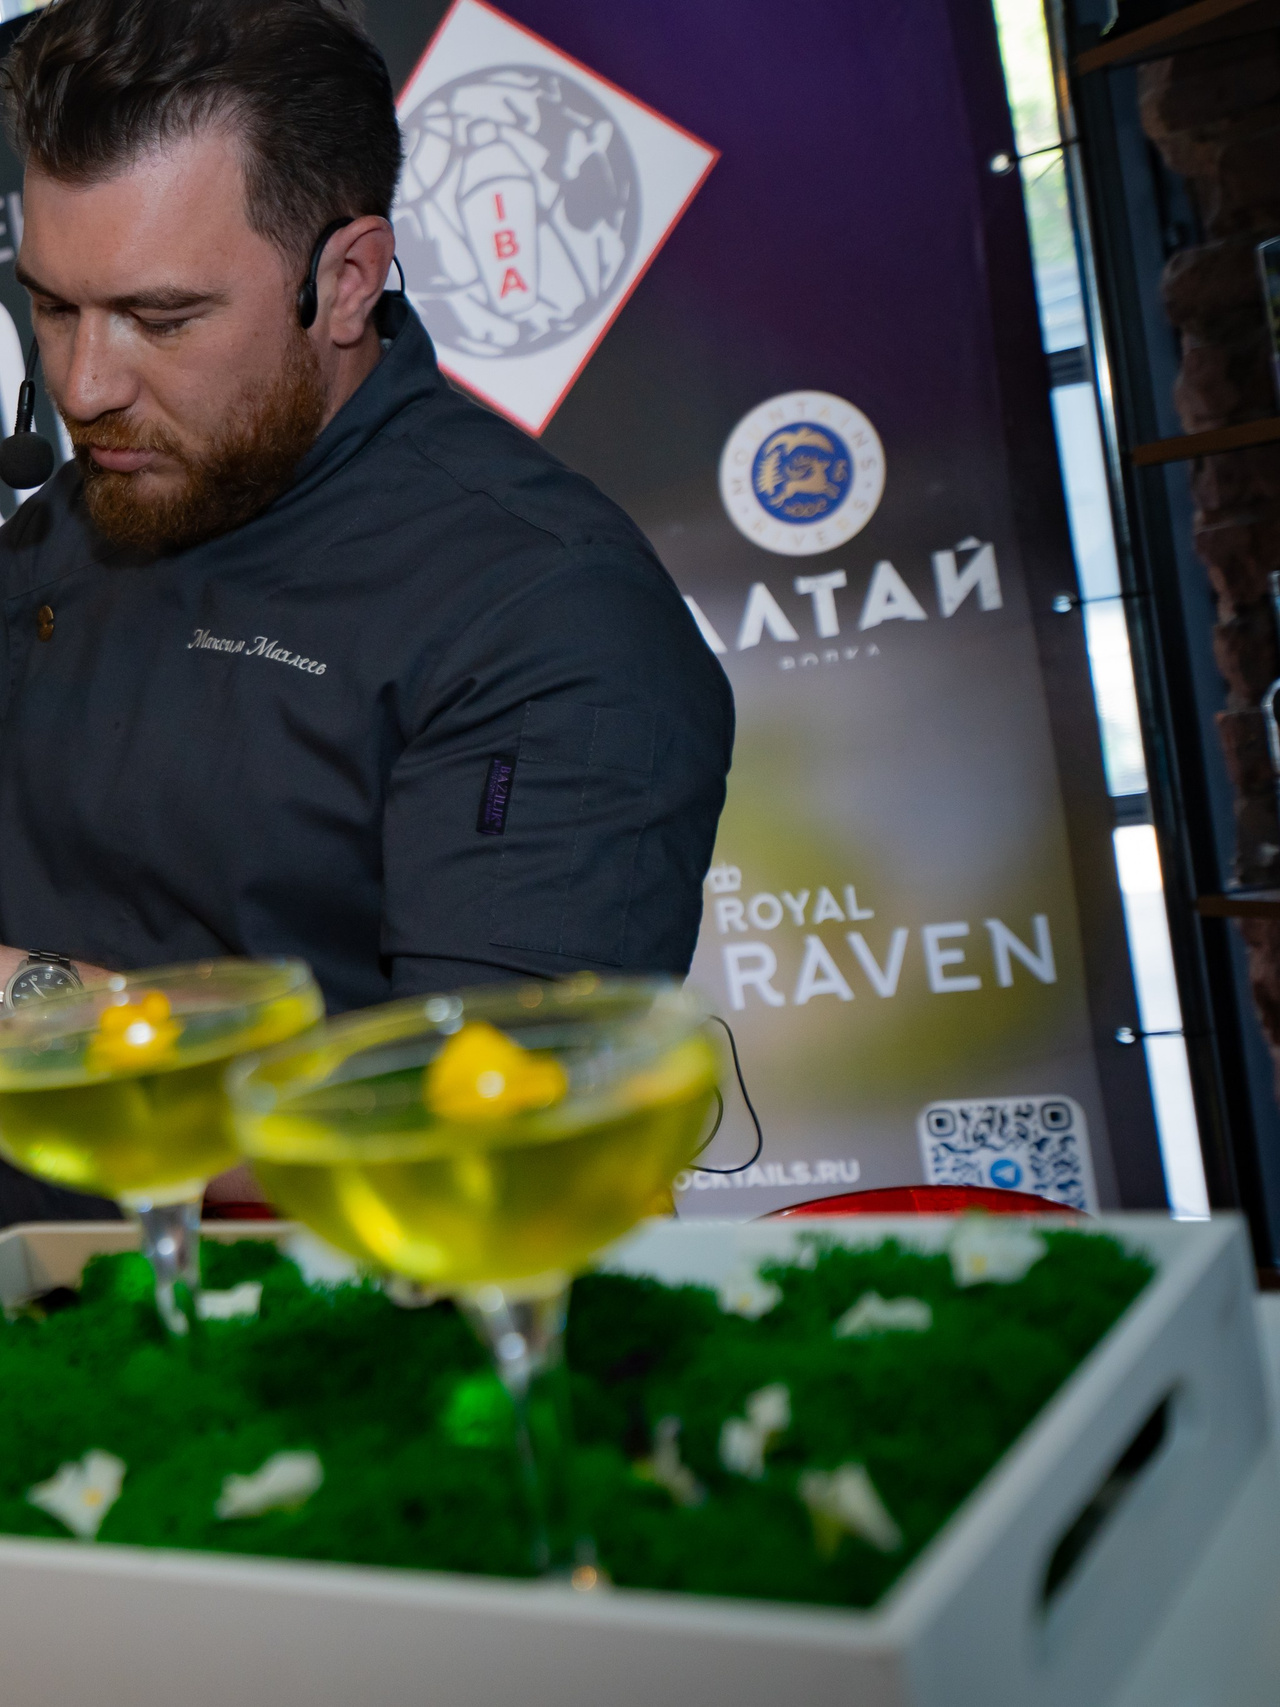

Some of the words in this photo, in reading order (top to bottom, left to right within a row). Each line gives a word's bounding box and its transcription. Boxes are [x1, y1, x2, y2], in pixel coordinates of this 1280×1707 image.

[493, 191, 528, 299] IBA
[187, 629, 245, 653] Максим
[245, 635, 328, 676] Махлеев
[714, 884, 875, 934] ROYAL
[722, 912, 1058, 1011] RAVEN
